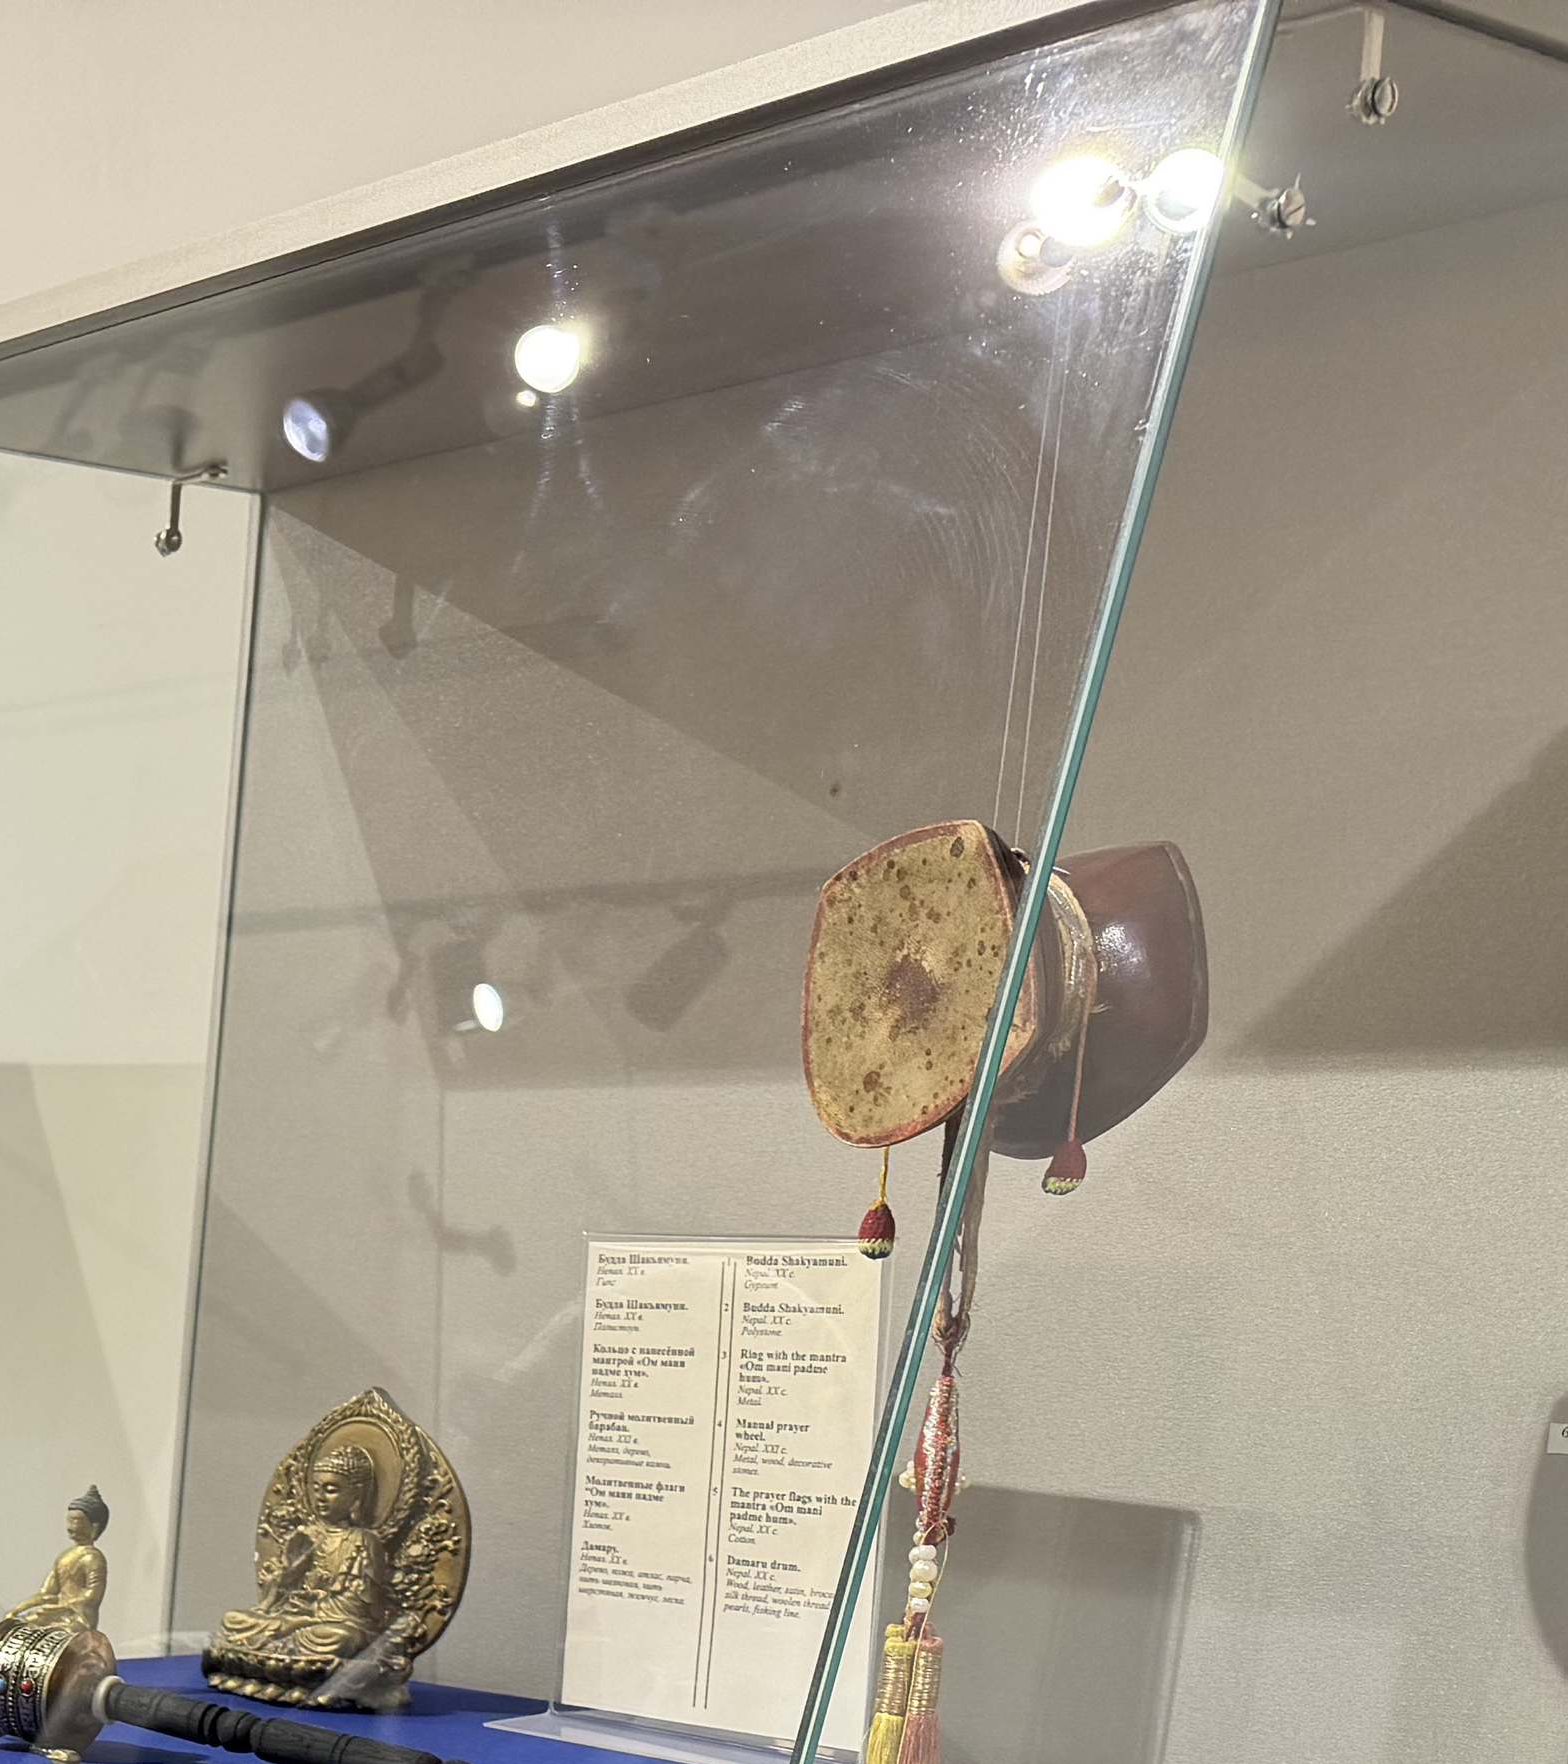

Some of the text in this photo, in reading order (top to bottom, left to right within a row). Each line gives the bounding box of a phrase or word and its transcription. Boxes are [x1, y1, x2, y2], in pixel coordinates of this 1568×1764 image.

[778, 1303, 844, 1316] Shakyamuni.
[740, 1349, 847, 1363] Ring with the mantra
[766, 1363, 790, 1372] mani
[794, 1364, 828, 1375] padme
[736, 1418, 811, 1433] Manual prayer
[732, 1487, 857, 1507] The prayer flags with the
[730, 1500, 766, 1511] mantra
[797, 1505, 823, 1516] mani
[727, 1555, 801, 1572] Damaru drum.
